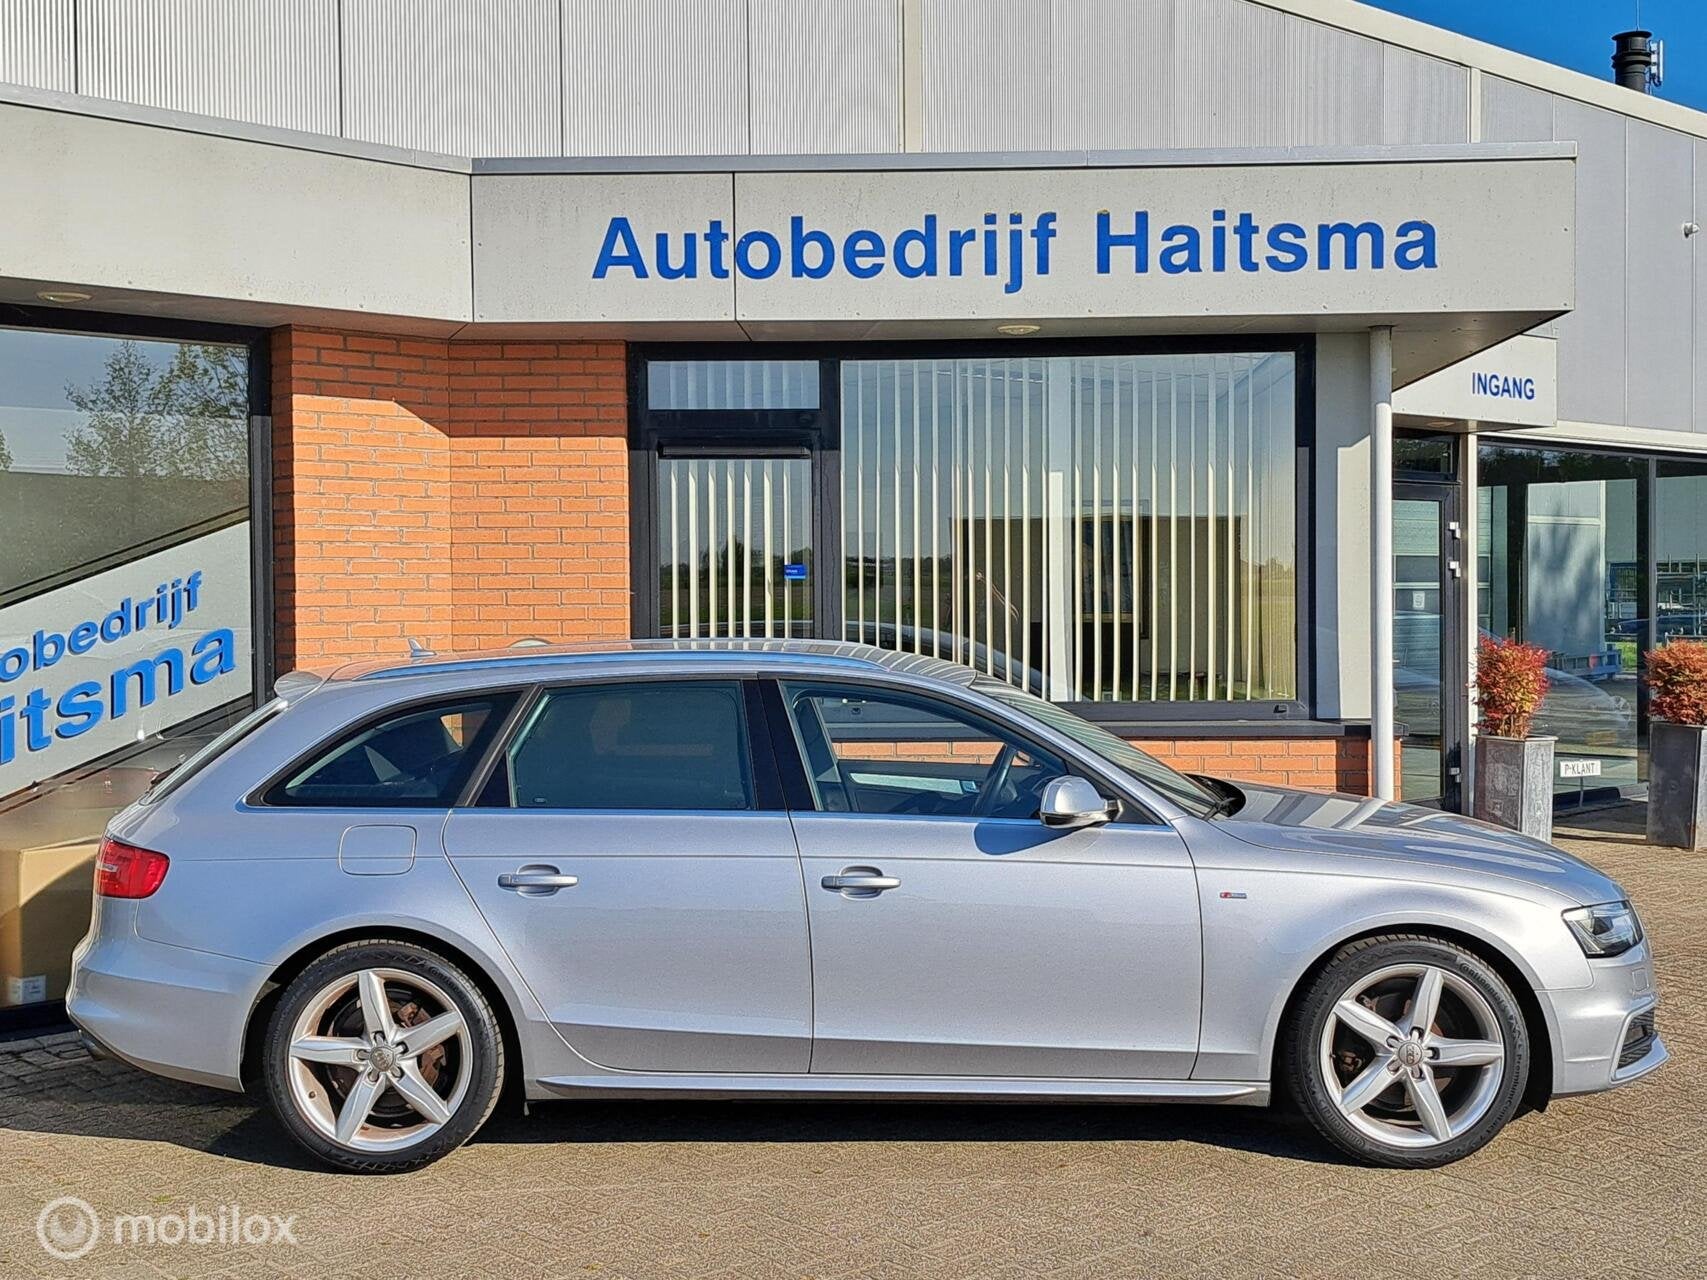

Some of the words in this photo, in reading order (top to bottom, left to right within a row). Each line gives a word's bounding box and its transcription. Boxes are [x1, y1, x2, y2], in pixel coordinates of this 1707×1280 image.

[591, 211, 1057, 294] Autobedrijf
[1096, 209, 1437, 274] Haitsma
[1472, 372, 1535, 400] INGANG
[1564, 762, 1596, 775] P-KLANT
